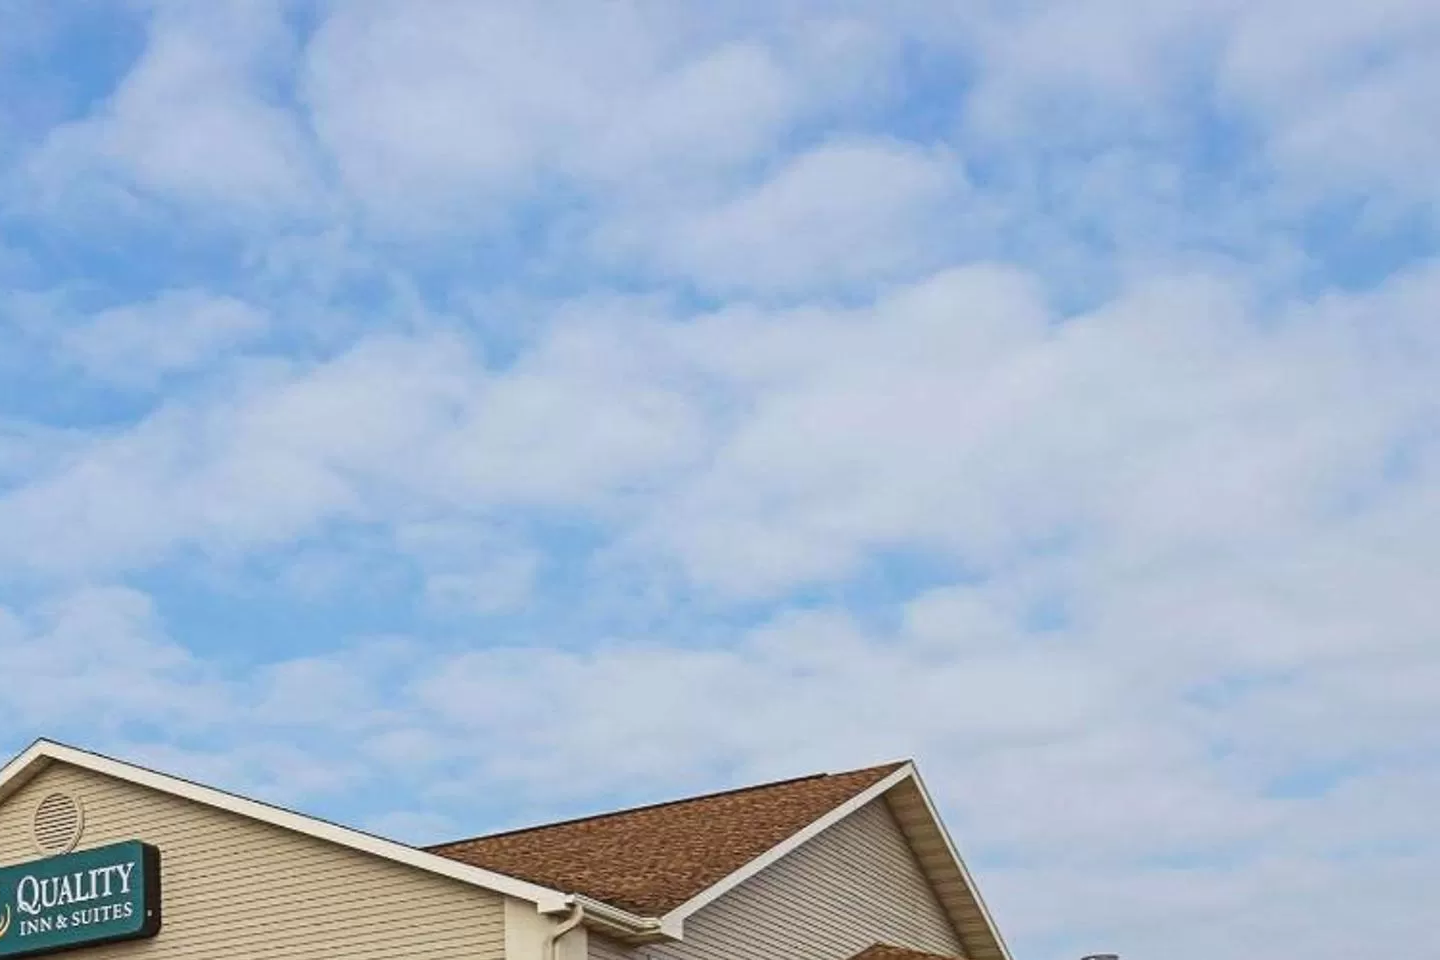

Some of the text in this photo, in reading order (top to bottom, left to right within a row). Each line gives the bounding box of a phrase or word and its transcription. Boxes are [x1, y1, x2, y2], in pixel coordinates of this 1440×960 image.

[17, 862, 135, 915] QUALITY
[20, 901, 133, 936] INN & SUITES
